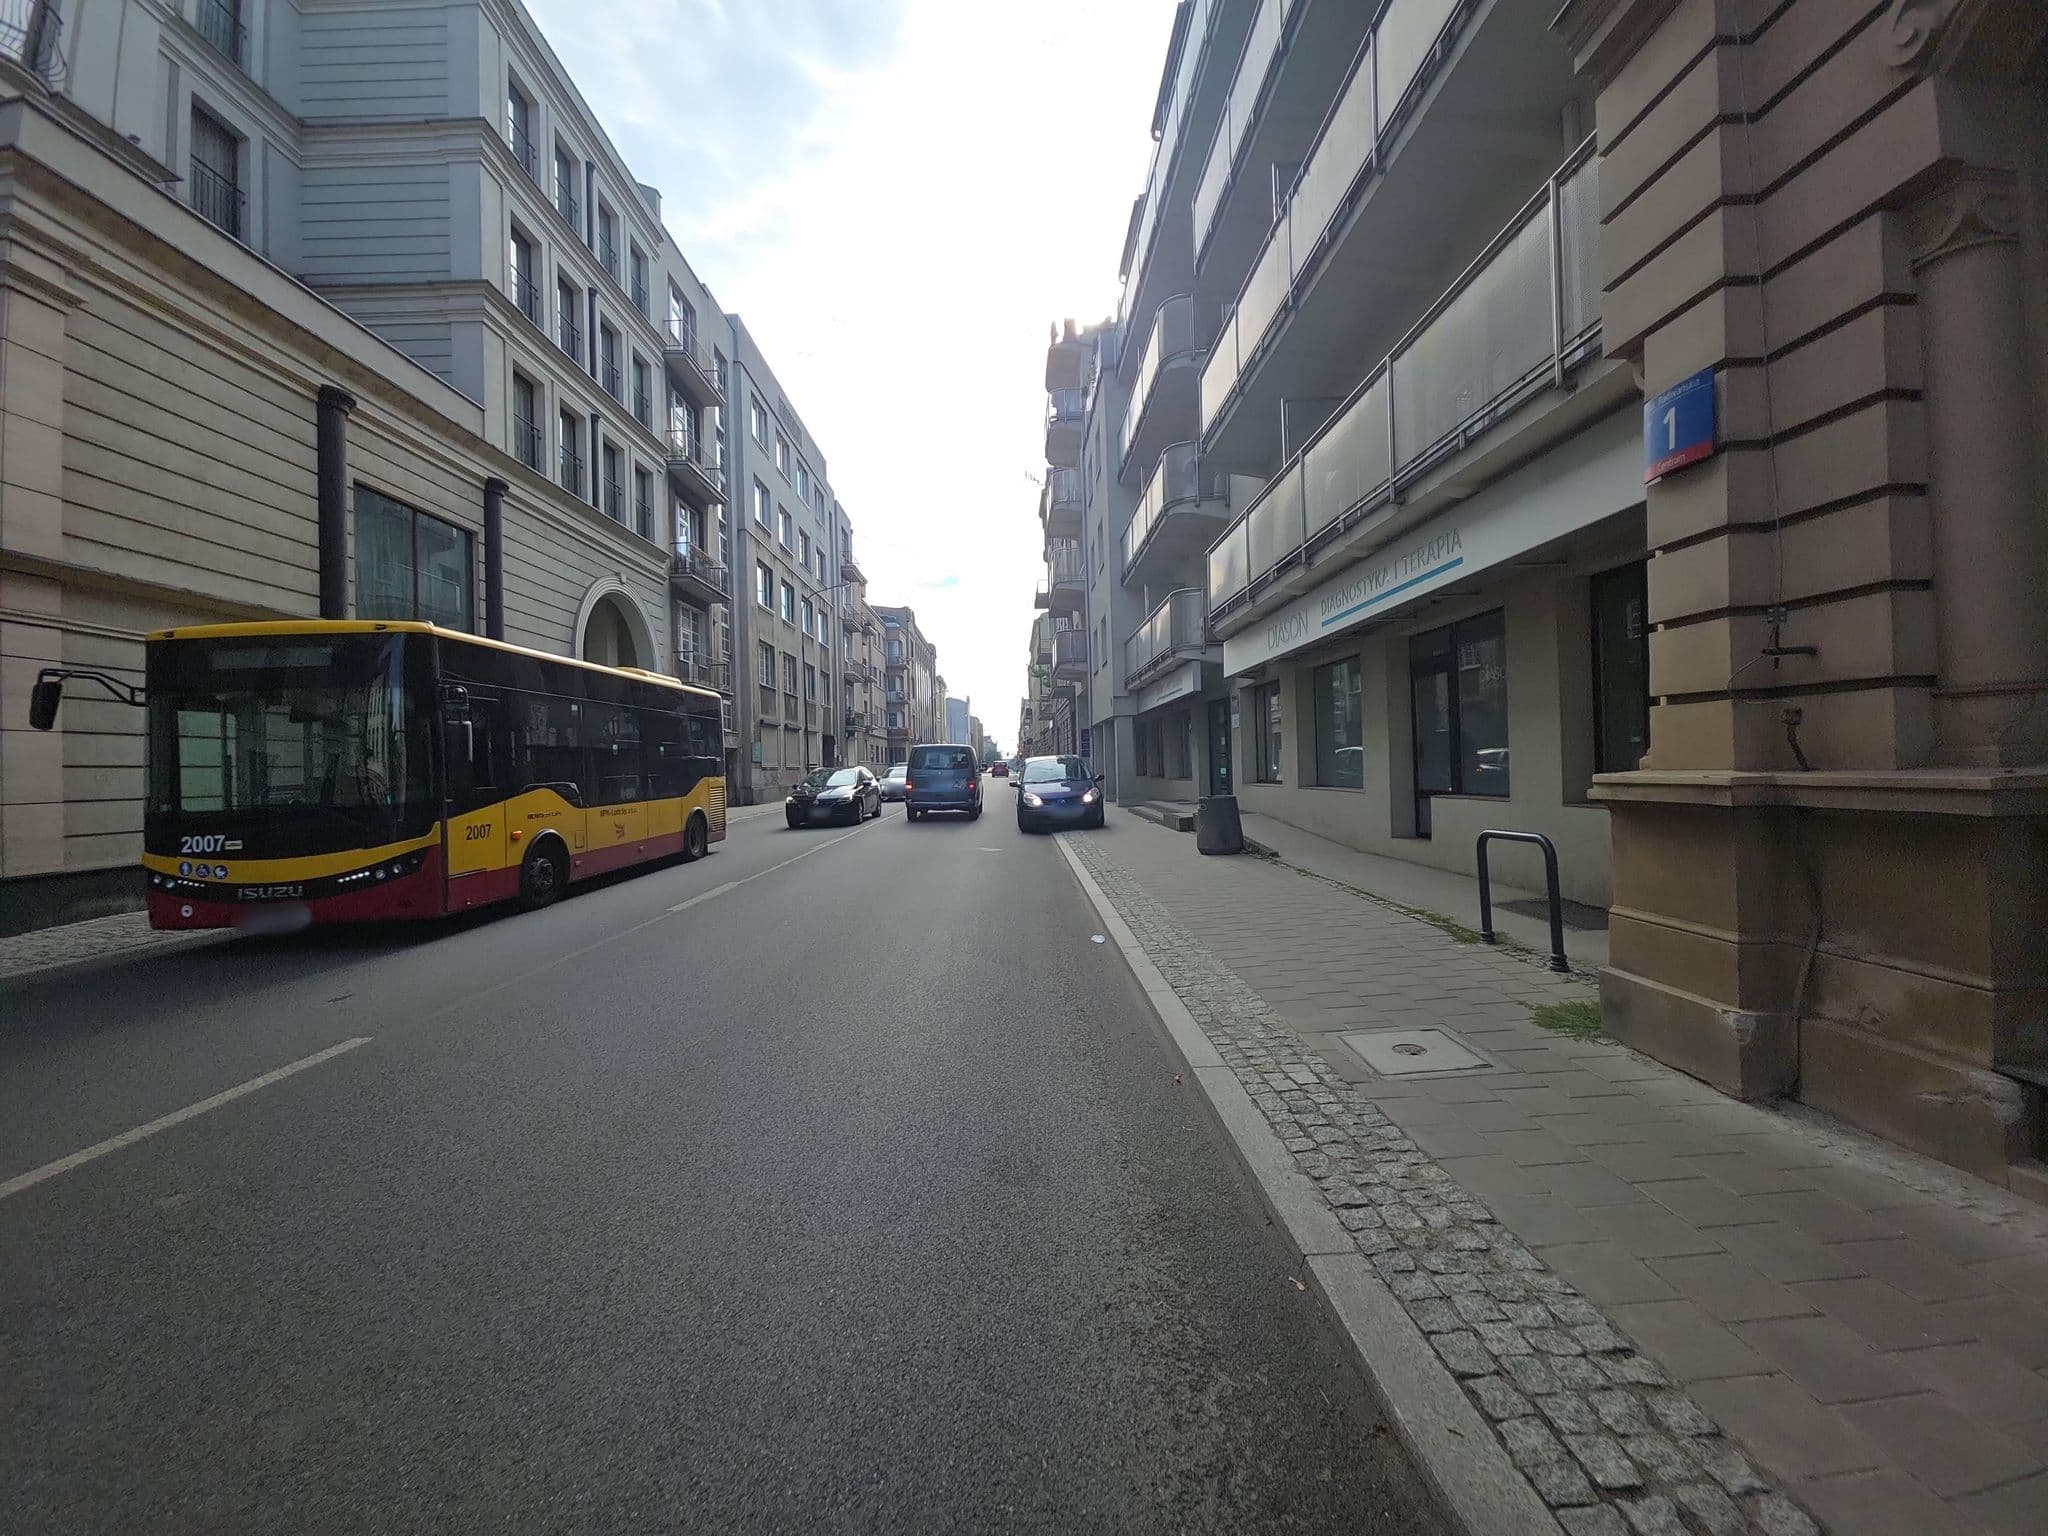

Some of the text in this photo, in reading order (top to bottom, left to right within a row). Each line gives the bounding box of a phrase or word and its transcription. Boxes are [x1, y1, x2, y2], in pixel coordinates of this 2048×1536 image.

[1664, 407, 1676, 449] 1
[1657, 454, 1685, 471] Centrum
[1321, 527, 1462, 615] DIAGNOSTYKA I TERAPIA
[1267, 608, 1309, 651] DIASON
[466, 823, 492, 841] 2007
[181, 835, 225, 853] 2007
[237, 885, 303, 900] ISUZU
